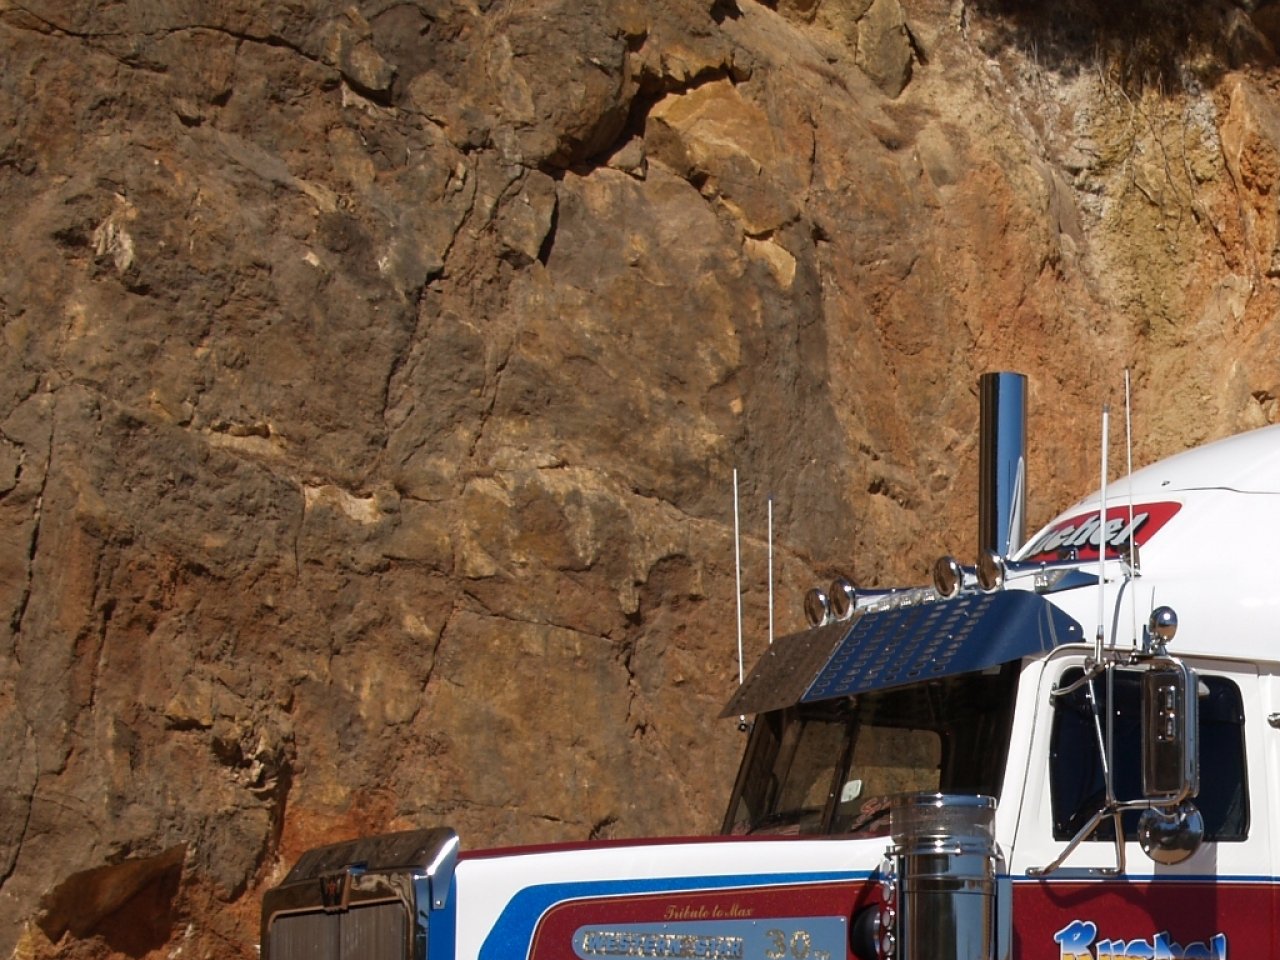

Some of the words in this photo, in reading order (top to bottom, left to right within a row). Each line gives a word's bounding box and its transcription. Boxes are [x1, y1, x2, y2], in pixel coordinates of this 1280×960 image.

[664, 904, 709, 920] Tribute
[712, 904, 725, 917] to
[724, 903, 754, 917] Max
[583, 931, 683, 958] WESTERN
[693, 935, 744, 960] STAR
[766, 928, 811, 960] 30
